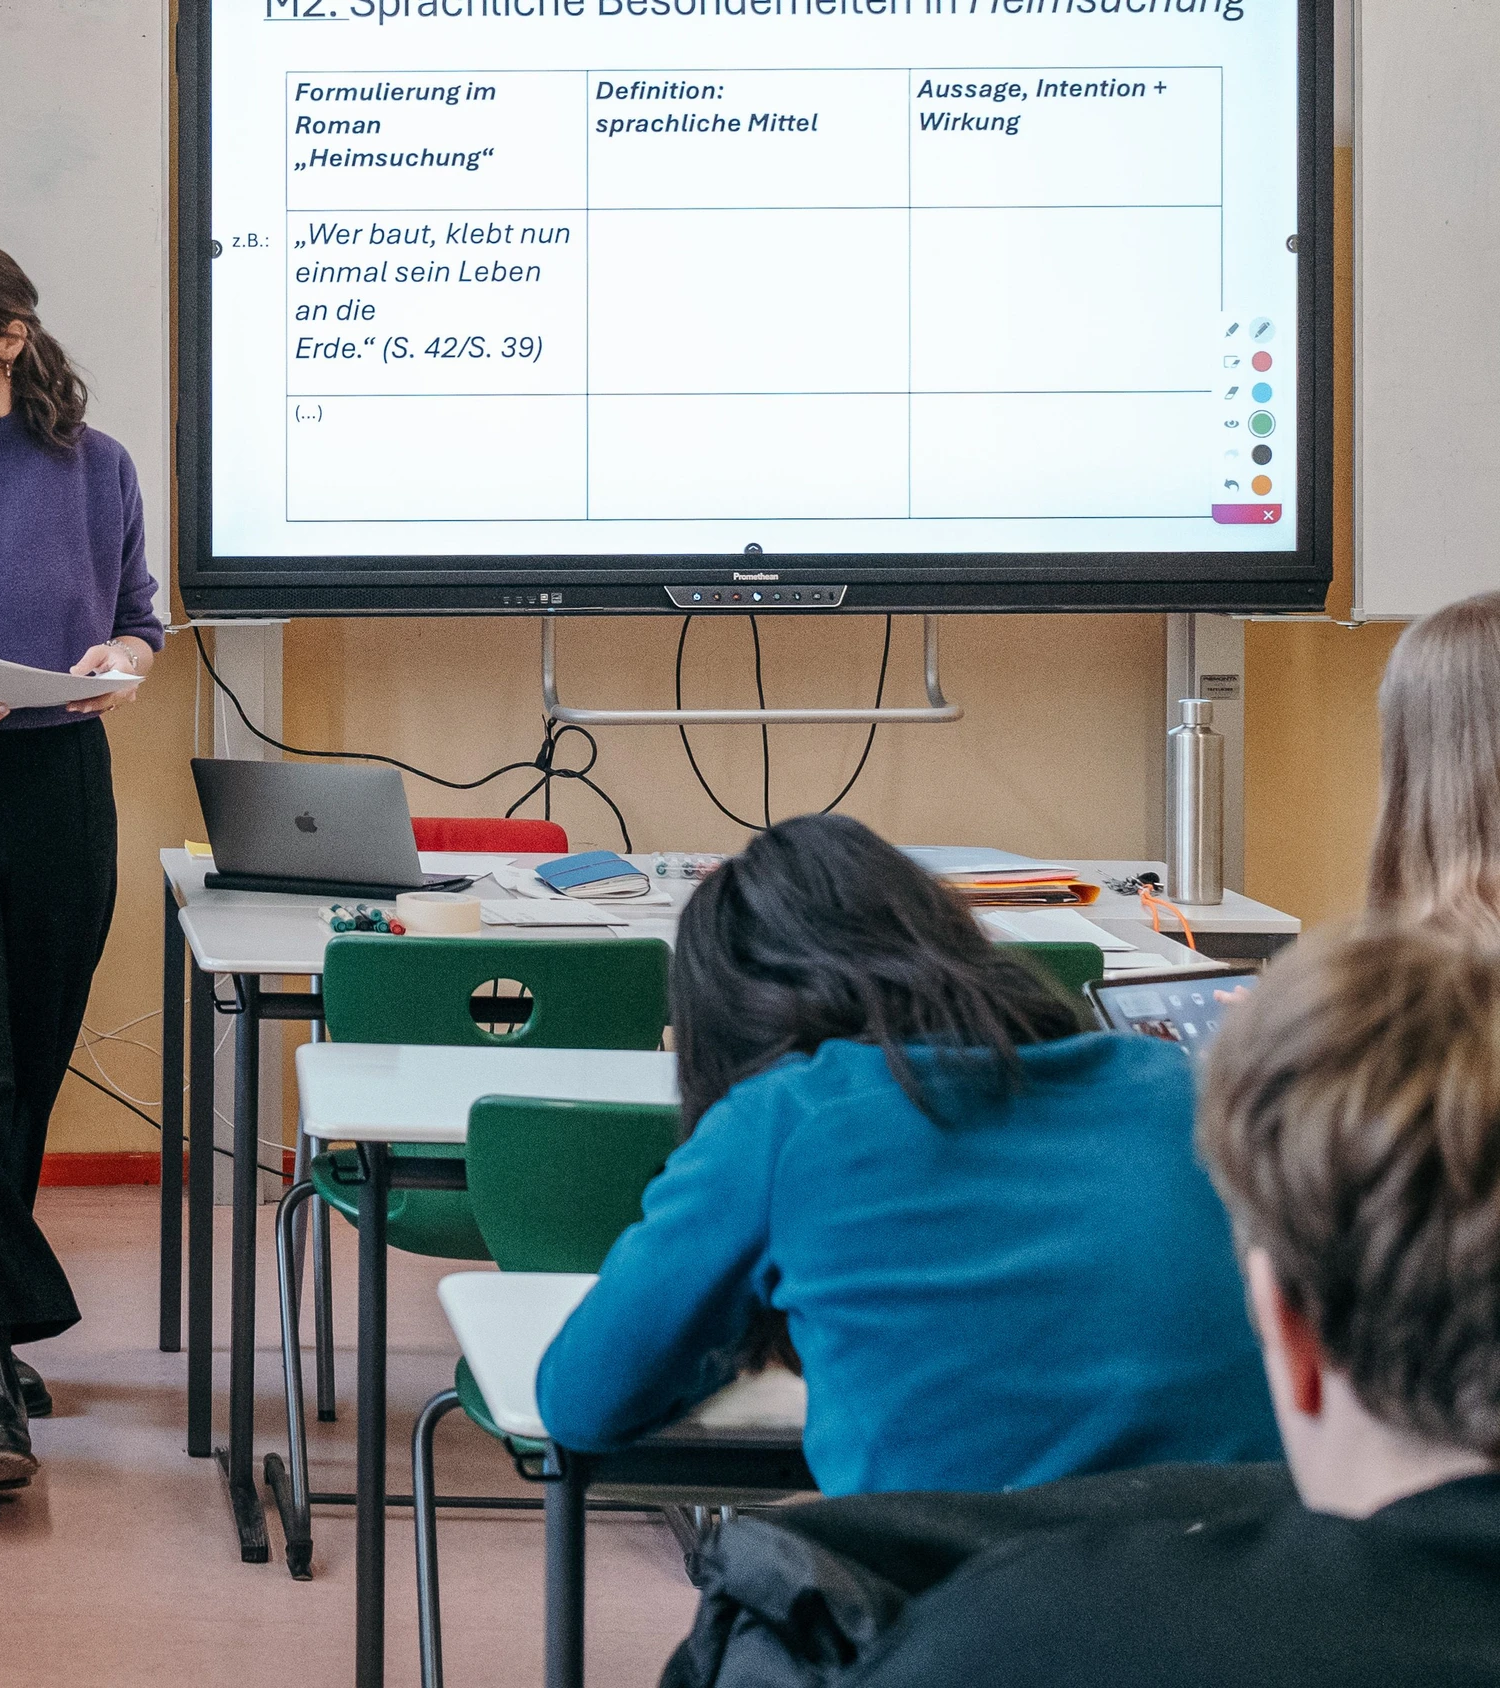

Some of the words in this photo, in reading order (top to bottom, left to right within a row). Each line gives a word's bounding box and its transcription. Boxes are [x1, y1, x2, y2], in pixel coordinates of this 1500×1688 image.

[295, 81, 461, 105] Formulierung
[466, 82, 497, 100] im
[595, 80, 725, 100] Definition:
[916, 79, 1028, 102] Aussage,
[1036, 78, 1146, 98] Intention
[1153, 80, 1167, 95] +
[295, 115, 381, 135] Roman
[595, 113, 741, 137] sprachliche
[747, 112, 818, 132] Mittel
[919, 111, 1022, 136] Wirkung
[232, 233, 270, 249] z.B.:
[369, 222, 436, 249] baut,
[445, 222, 515, 245] klebt
[520, 227, 570, 244] nun
[295, 260, 388, 283] einmal
[394, 260, 450, 283] sein
[458, 260, 541, 283] Leben
[295, 304, 328, 321] an
[336, 298, 376, 321] die
[383, 336, 416, 364] (S.
[424, 335, 492, 361] 42/S.
[501, 335, 543, 364] 39)
[733, 572, 779, 581] Promethean
